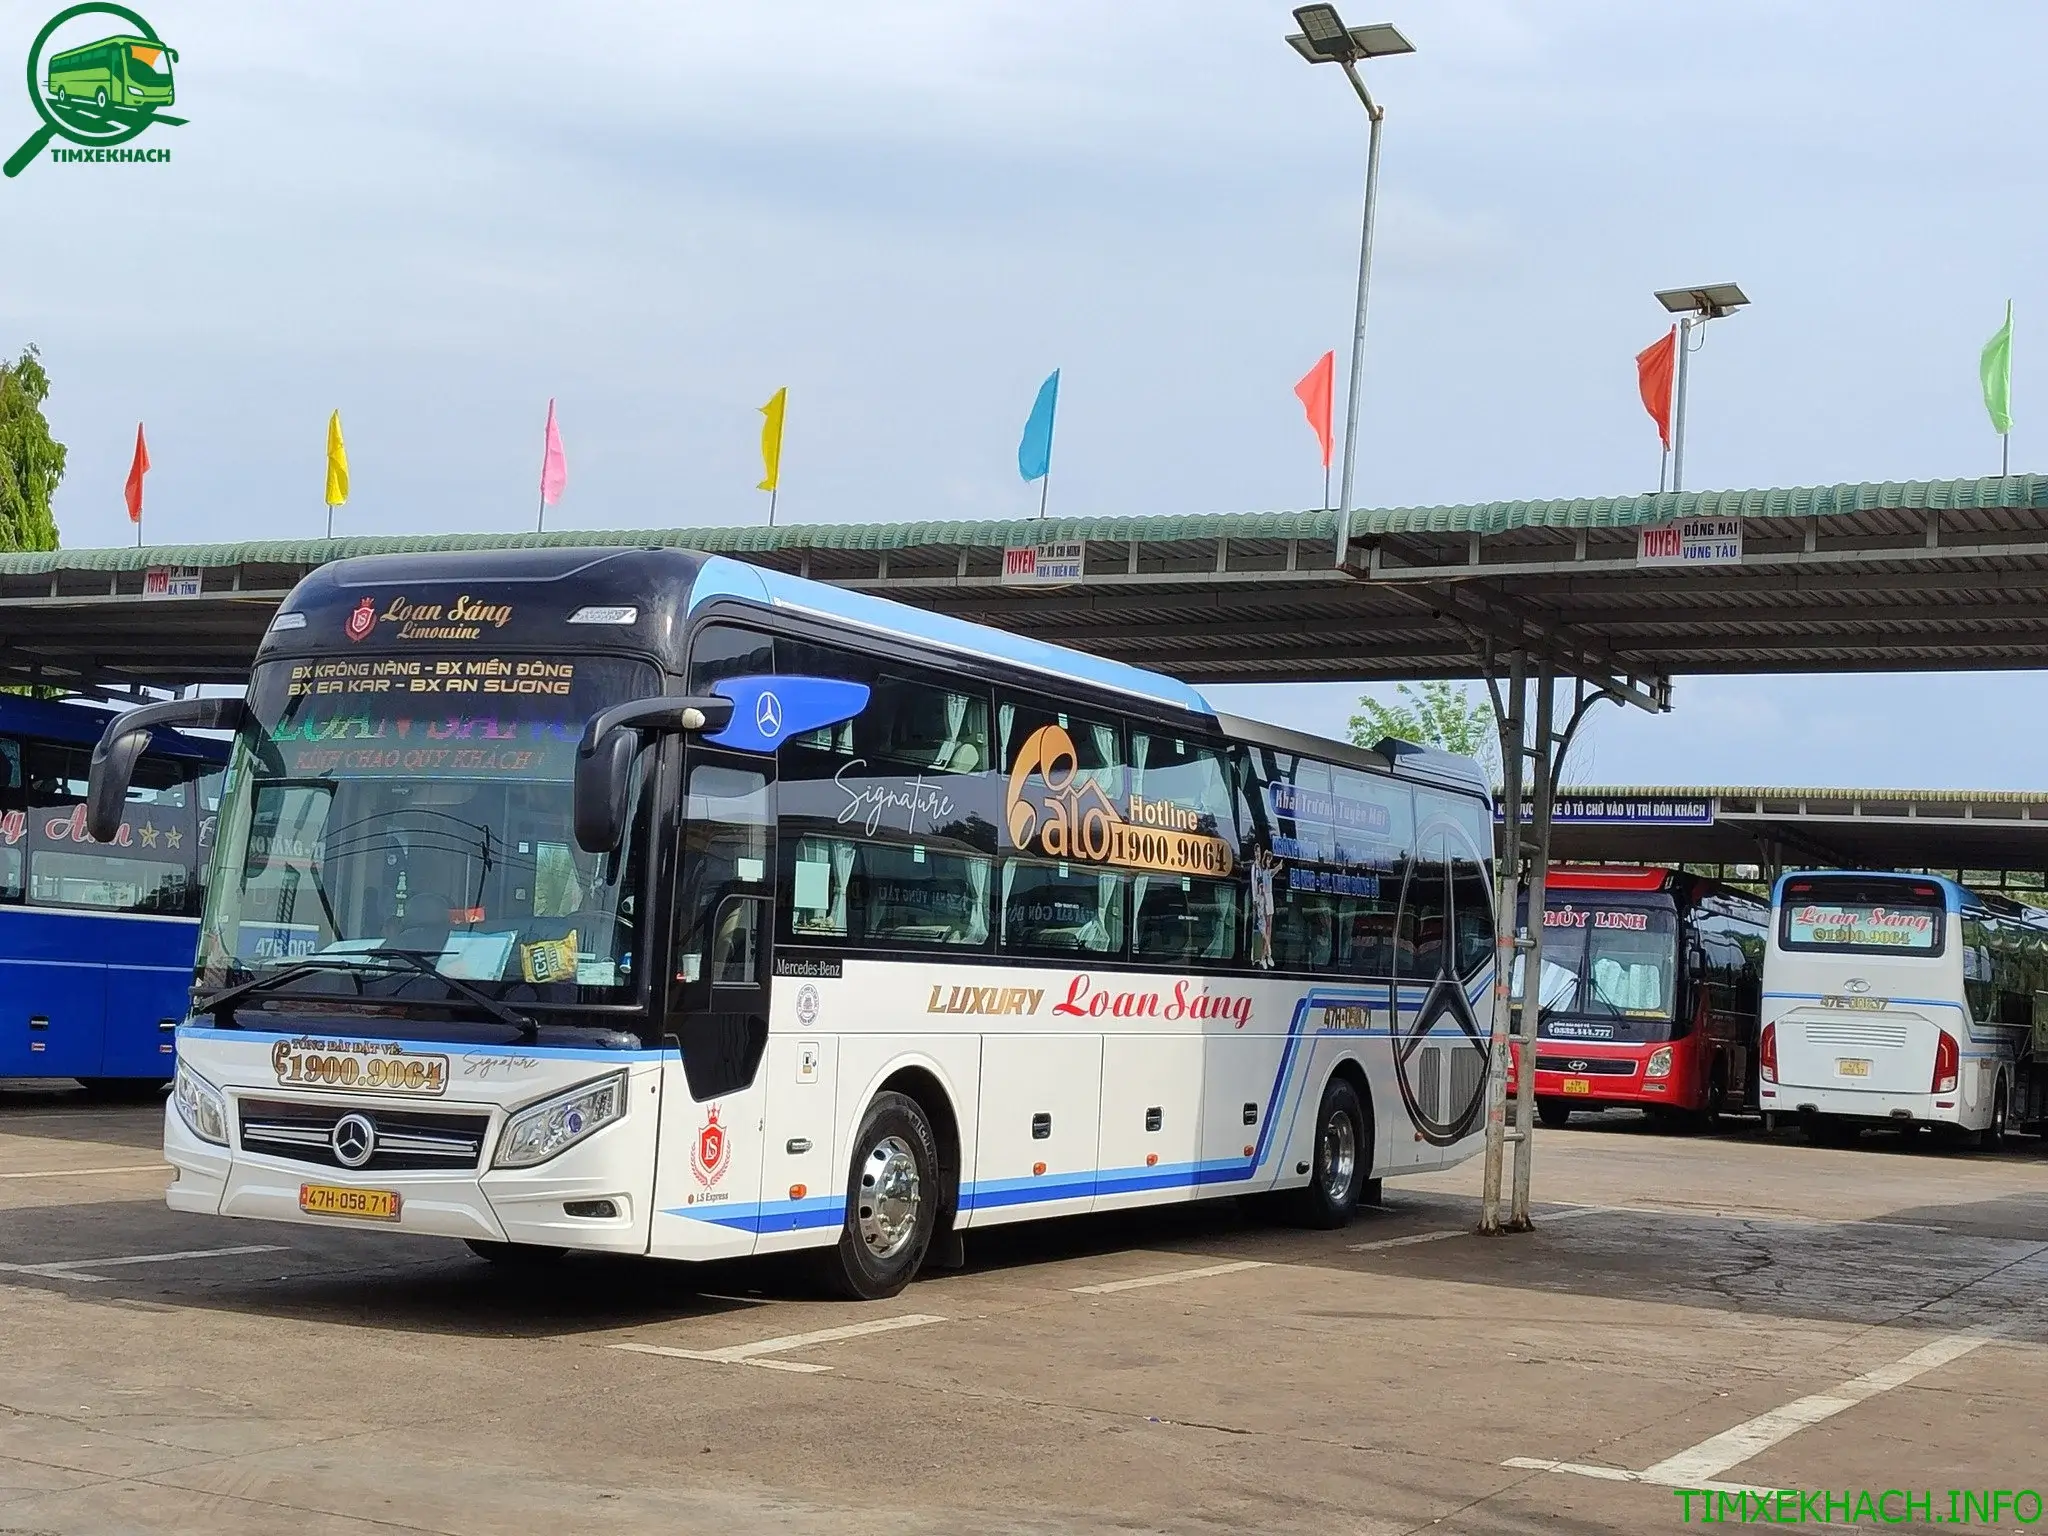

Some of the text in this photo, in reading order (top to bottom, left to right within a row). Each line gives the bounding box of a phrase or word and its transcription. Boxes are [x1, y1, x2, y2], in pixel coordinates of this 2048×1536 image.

[1644, 521, 1680, 557] TUYẾN
[1718, 522, 1738, 536] NAI
[1007, 545, 1036, 574] TUYẾN
[1683, 543, 1737, 559] VŨNG TÀU
[380, 595, 513, 628] Loan Sáng
[396, 621, 481, 640] Limousine
[292, 666, 313, 680] BX
[315, 661, 369, 677] KRÔNG
[436, 662, 462, 676] BX
[517, 660, 573, 678] ĐÔNG
[287, 682, 313, 696] BX
[316, 680, 343, 694] EA
[347, 679, 391, 693] KAR
[410, 679, 441, 692] BX
[445, 679, 478, 692] AN
[483, 679, 571, 695] SƯƠNG
[835, 759, 954, 836] Signature
[1130, 794, 1198, 830] Hotline
[1564, 801, 1571, 816] Ô
[1606, 801, 1624, 816] VÀO
[1626, 803, 1635, 819] VỊ
[1637, 801, 1651, 816] TRÍ
[1674, 801, 1705, 817] KHÁCH
[1115, 829, 1227, 872] 1900.9064
[1544, 905, 1647, 930] HỦY LINH
[1796, 905, 1860, 926] Loan
[1866, 907, 1931, 934] Sáng
[776, 959, 840, 976] Mercedes-Benz
[927, 973, 1253, 1029] LUXURY Loan Sáng
[286, 1054, 443, 1090] 1900.9064
[462, 1049, 539, 1078] Signature
[696, 1192, 729, 1203] LS Express
